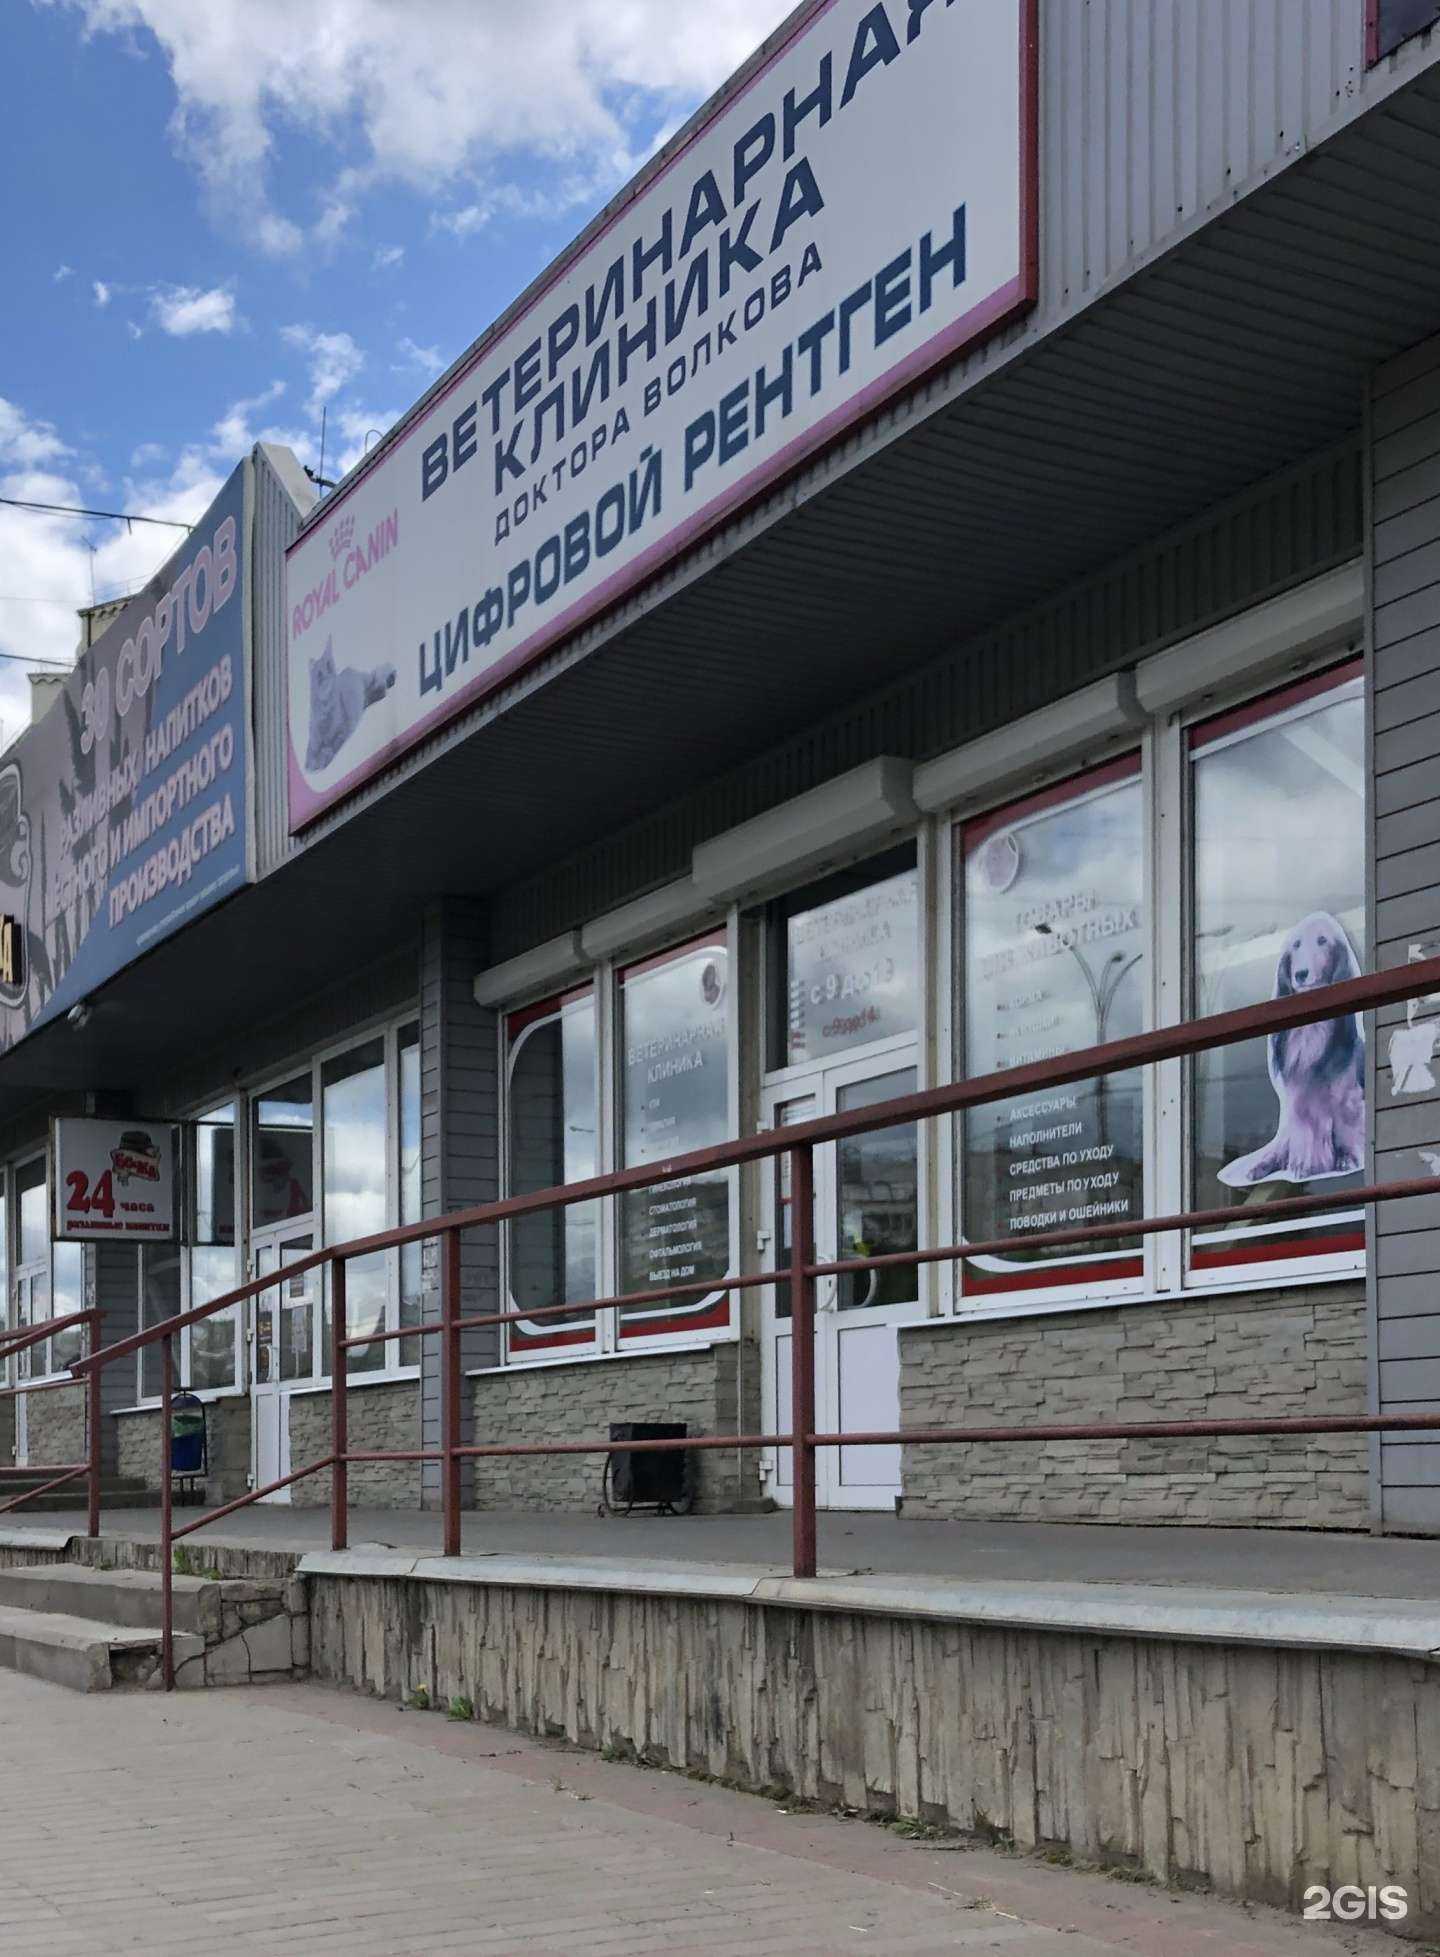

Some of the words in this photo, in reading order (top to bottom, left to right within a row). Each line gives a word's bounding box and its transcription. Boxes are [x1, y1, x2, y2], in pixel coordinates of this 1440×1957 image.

[494, 156, 825, 497] КЛИНИКА
[418, 445, 663, 697] ЦИФРОВОЙ
[683, 201, 967, 492] РЕНТГЕН
[493, 406, 632, 547] ДОКТОРА
[643, 242, 823, 417] ВОЛКОВА
[115, 515, 238, 718] СОРТОВ
[293, 569, 340, 640] ROYAL
[343, 507, 398, 589] CANIN
[145, 654, 232, 776] НАПИТКОВ
[123, 721, 234, 858] ИМПОРТНОГО
[108, 794, 236, 929] ПРОИЗВОДСТВА
[647, 1050, 704, 1084] КЛИНИКА
[1010, 1095, 1077, 1121] АКСЕССУАРЫ
[66, 1169, 115, 1218] 24
[1009, 1121, 1082, 1148] НАПОЛНИТЕЛИ
[1009, 1154, 1060, 1176] СРЕДСТВА
[1062, 1151, 1076, 1166] ПО
[1079, 1144, 1114, 1164] УХОДУ
[1009, 1181, 1065, 1203] ПРЕДМЕТЫ
[1067, 1178, 1082, 1191] ПО
[1083, 1171, 1119, 1188] УХОДУ
[1009, 1211, 1057, 1231] ПОВОДКИ
[1059, 1210, 1066, 1221] И
[1068, 1199, 1128, 1220] ОШЕЙНИКИ
